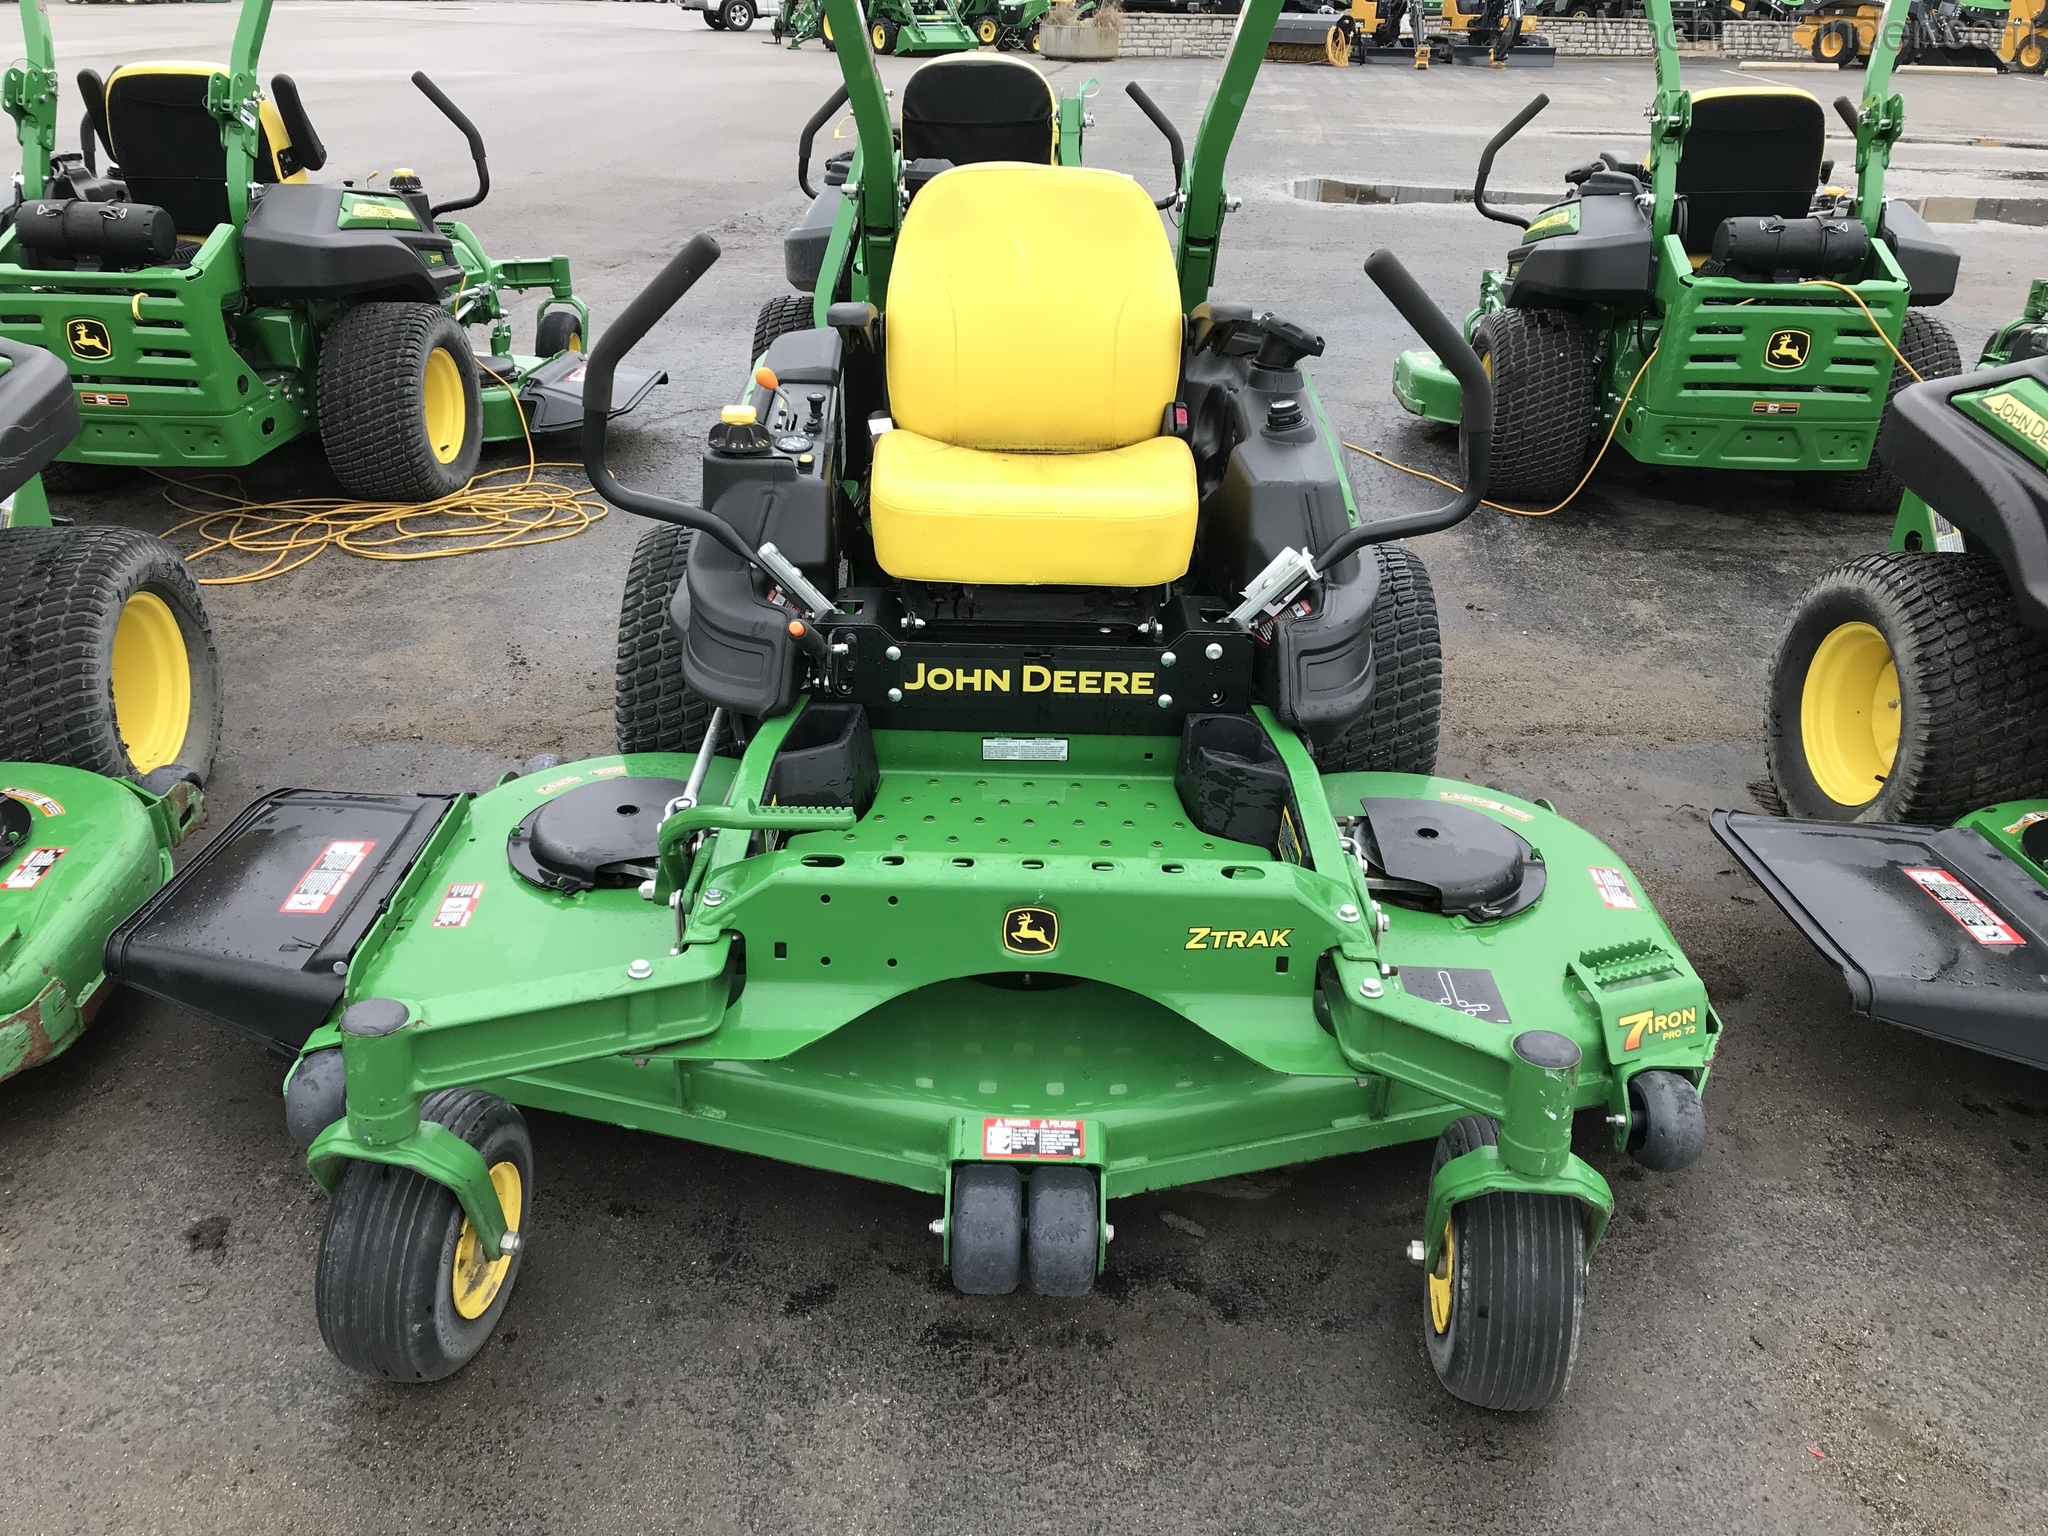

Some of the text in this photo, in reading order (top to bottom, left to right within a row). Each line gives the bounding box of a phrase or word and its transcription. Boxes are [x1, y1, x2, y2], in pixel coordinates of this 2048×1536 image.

[1994, 397, 2033, 431] JOHN
[904, 662, 1155, 695] JOHN DEERE
[1184, 926, 1295, 951] ZTRAK
[1662, 1025, 1696, 1041] PRO 72
[1003, 1119, 1031, 1128] DANGER
[1048, 1120, 1077, 1129] PELIGRO
